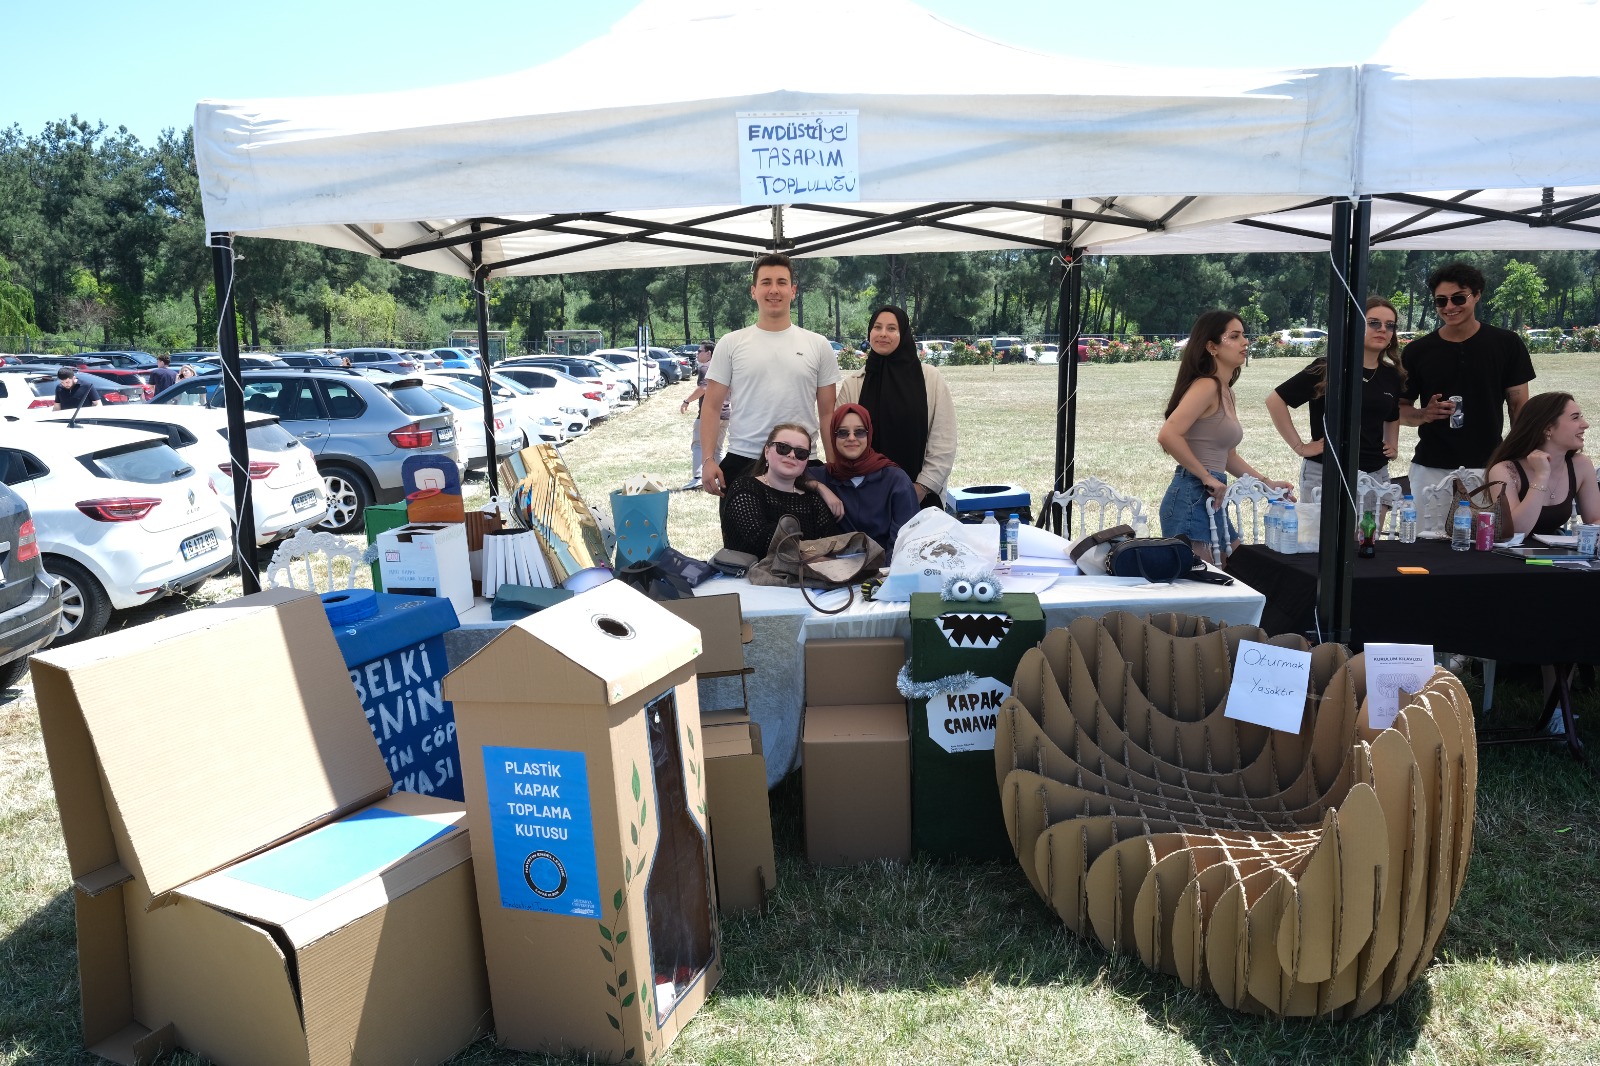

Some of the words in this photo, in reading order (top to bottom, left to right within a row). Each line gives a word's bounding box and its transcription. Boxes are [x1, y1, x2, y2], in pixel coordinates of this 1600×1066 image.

[751, 147, 844, 170] TASARIM
[756, 175, 856, 196] TOPLULUĞU
[350, 642, 432, 706] BELKİ
[946, 689, 1004, 713] KAPAK
[943, 714, 998, 735] CANAVA
[504, 761, 562, 778] PLASTİK
[514, 782, 560, 799] KAPAK
[507, 802, 572, 820] TOPLAMA
[515, 823, 568, 841] KUTUSU
